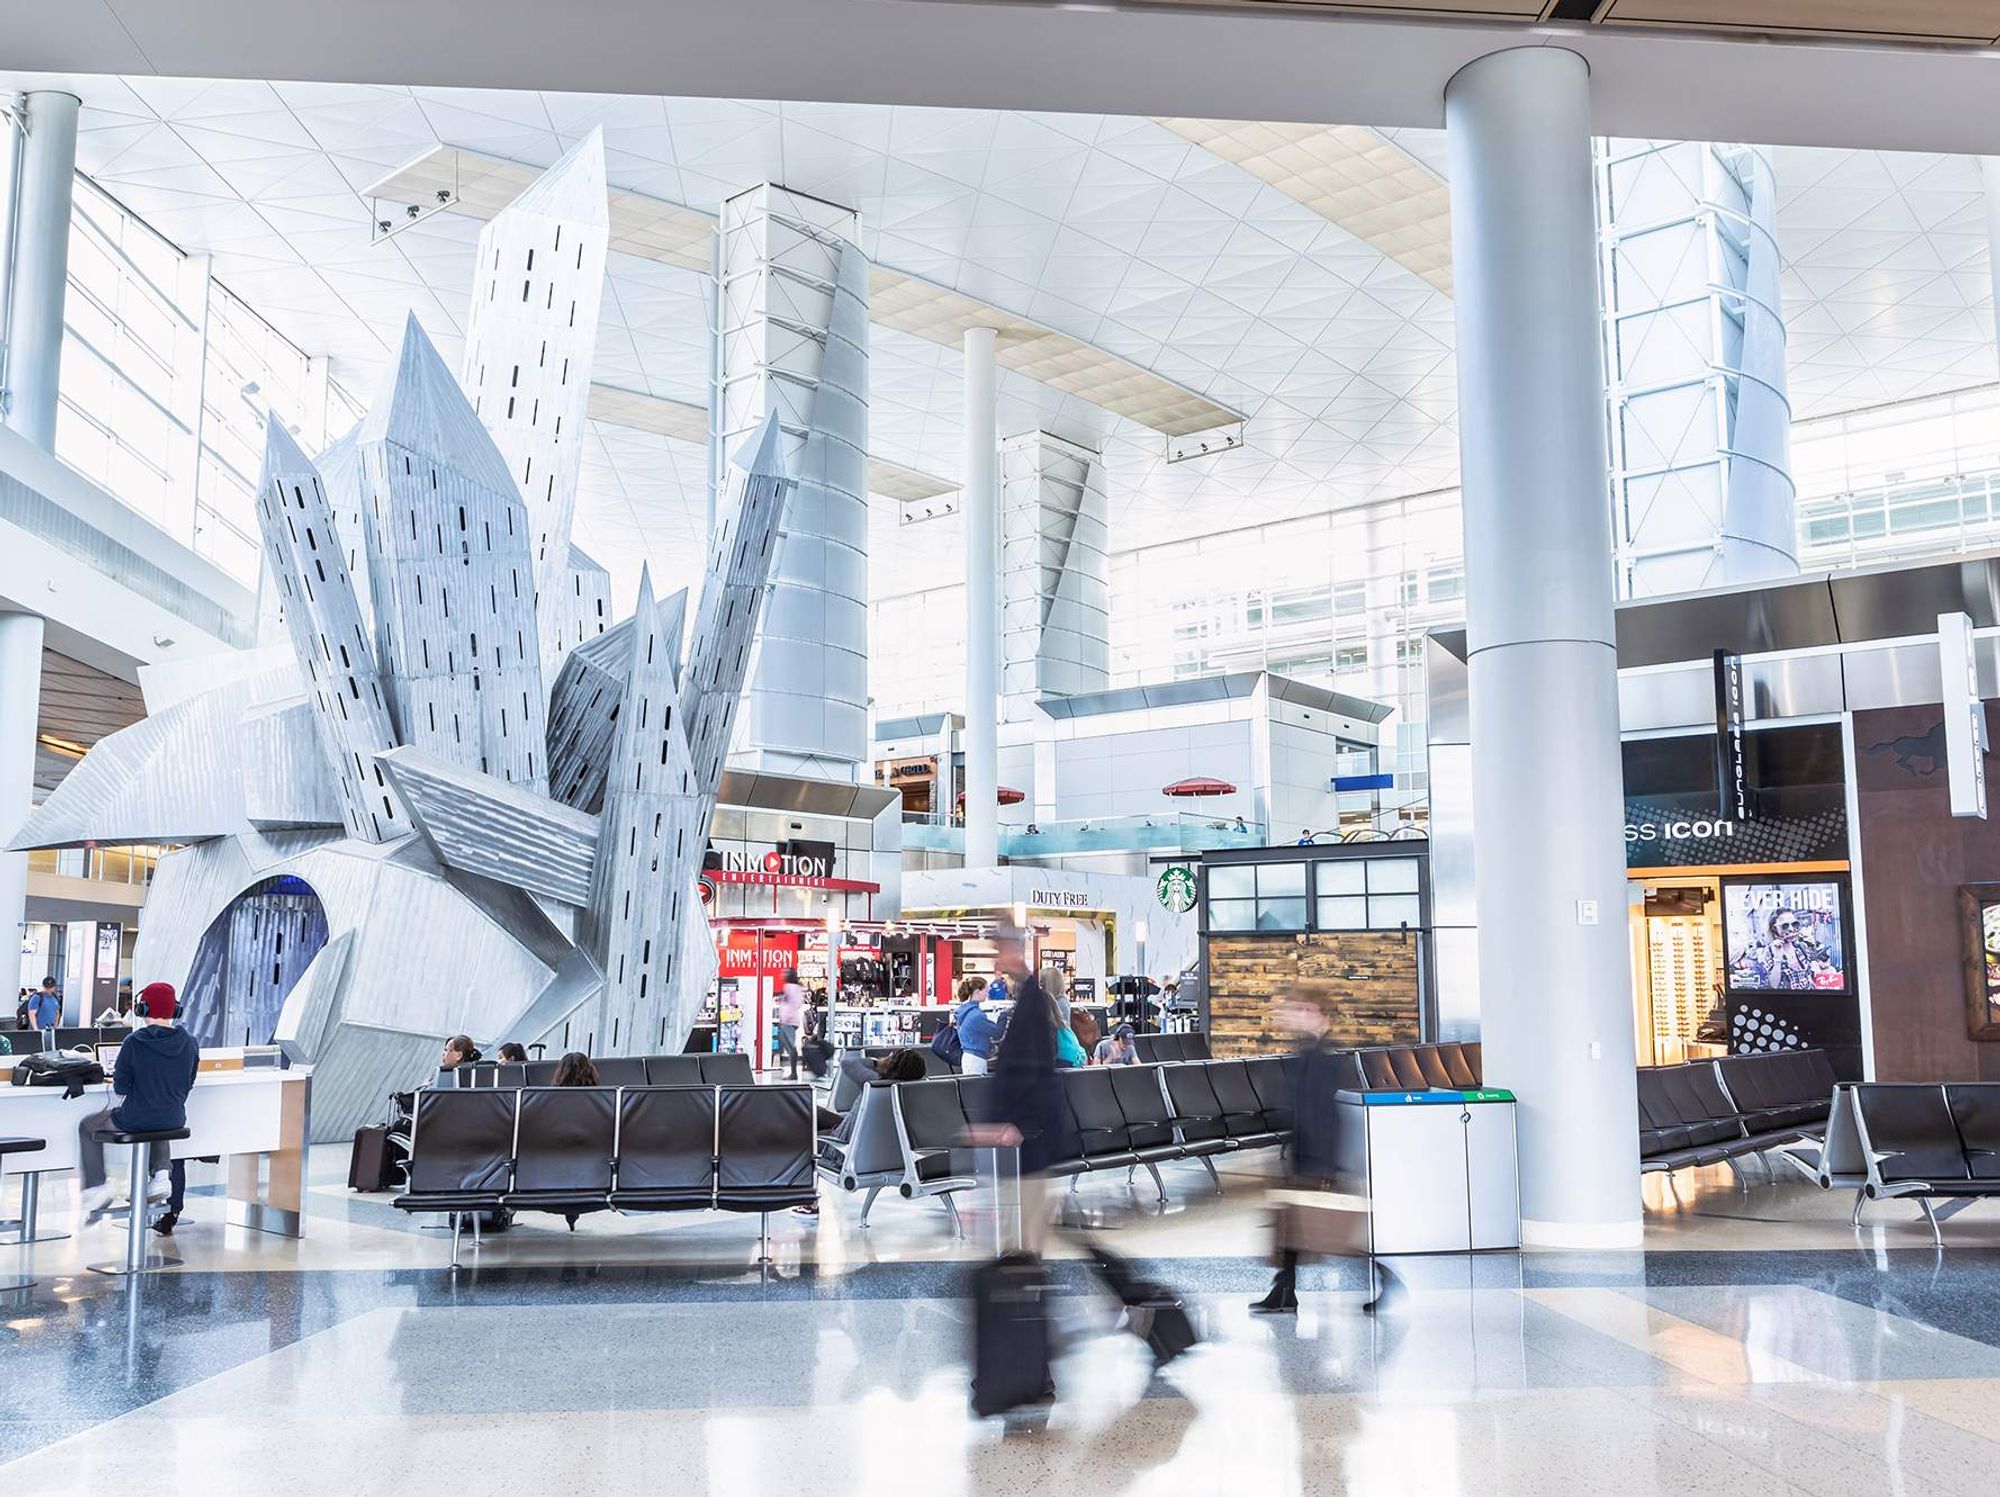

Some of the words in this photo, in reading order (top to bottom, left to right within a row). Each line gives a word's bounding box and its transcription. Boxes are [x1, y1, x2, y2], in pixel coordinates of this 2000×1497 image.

[722, 873, 826, 887] ENTERTAINMENT
[1032, 889, 1061, 906] DUTY
[1063, 891, 1088, 907] FREE
[1789, 887, 1834, 910] HIDE
[726, 948, 793, 963] INMTION
